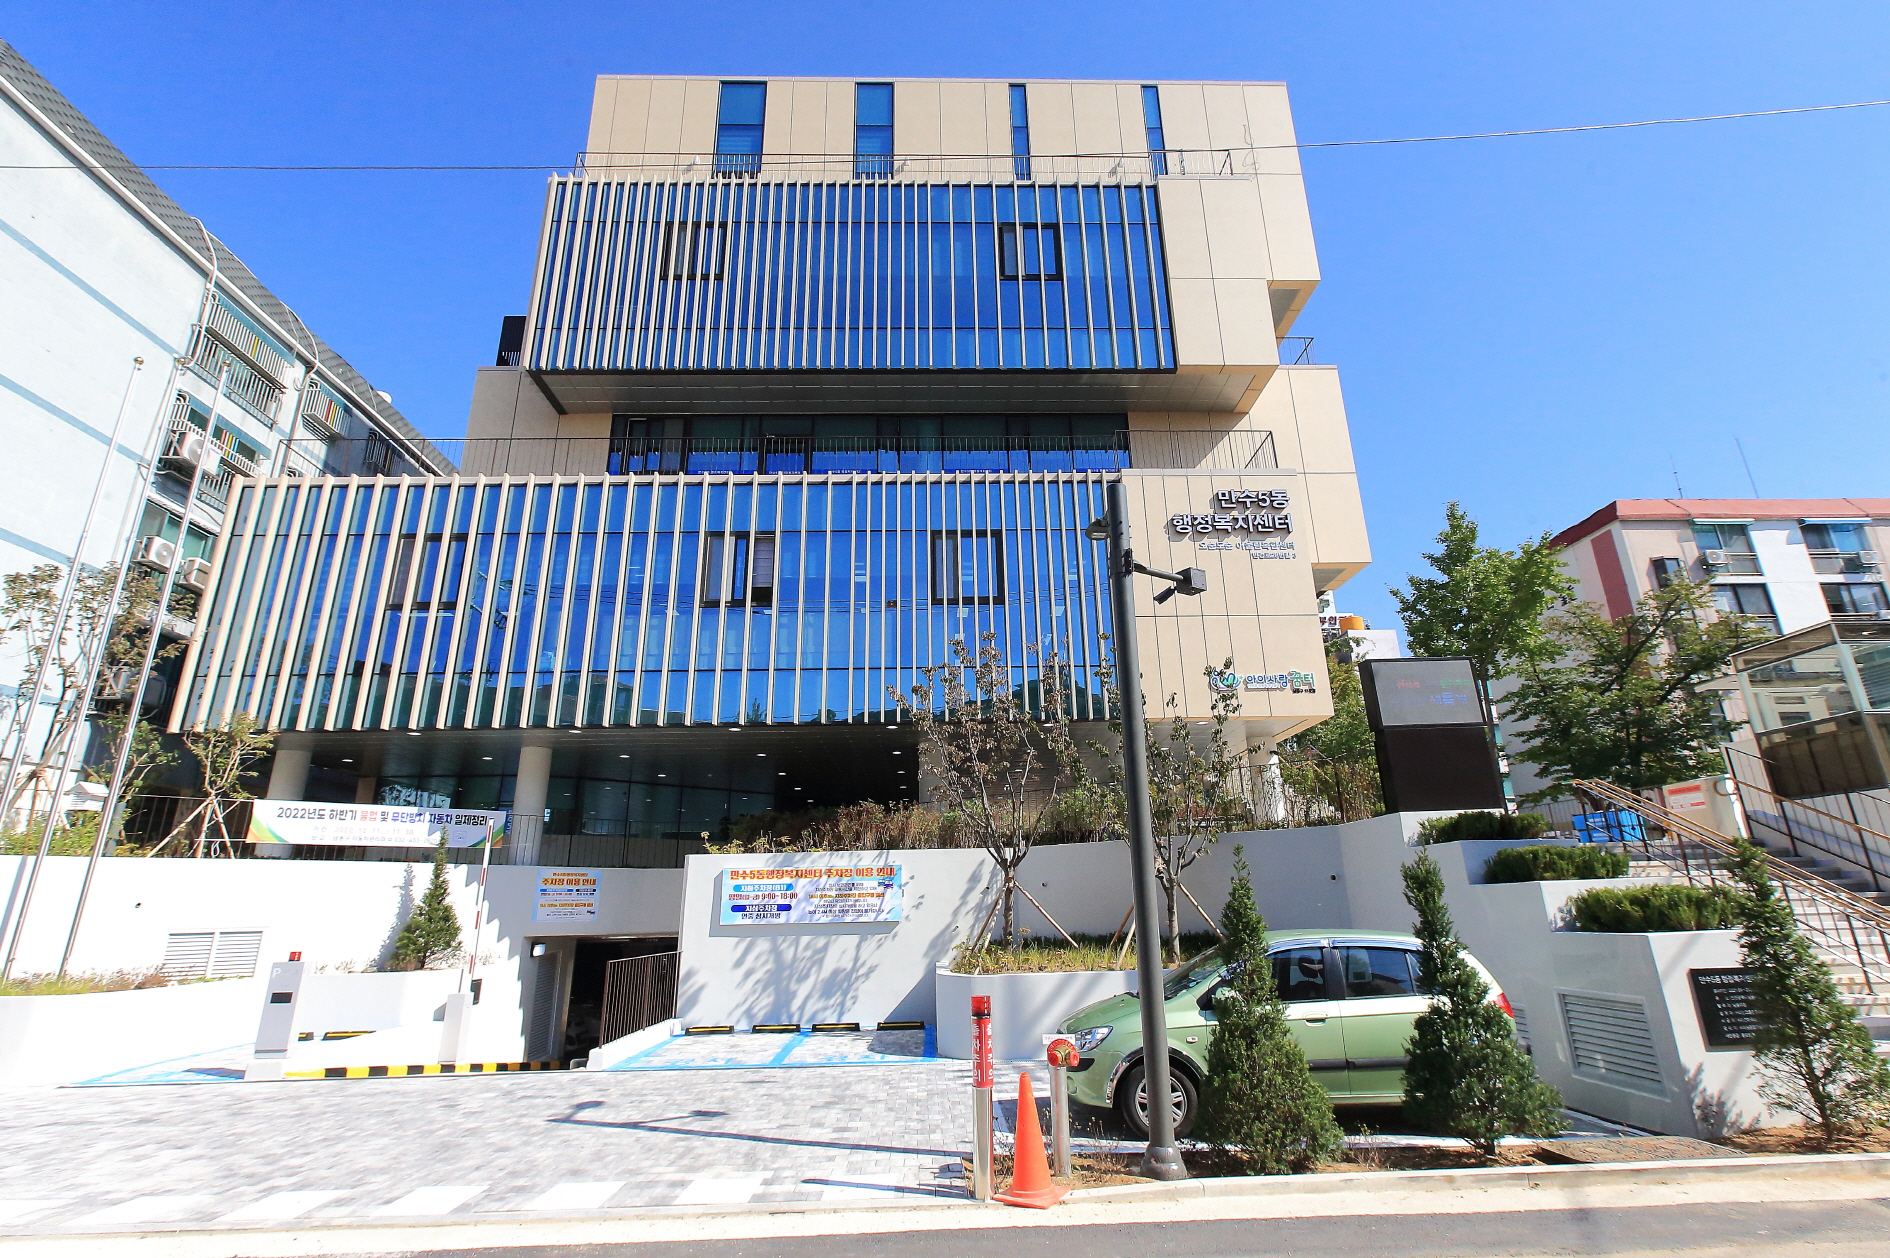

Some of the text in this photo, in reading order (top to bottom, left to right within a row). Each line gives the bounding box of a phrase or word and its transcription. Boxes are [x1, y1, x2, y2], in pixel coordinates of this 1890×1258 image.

[1217, 489, 1290, 508] 만수5동
[1172, 512, 1293, 533] 행정복지센터
[1247, 670, 1315, 688] 아이사랑꿈터
[277, 807, 488, 826] 2022년도 하반기 불법 및 무단방치 자동차 일제정리
[730, 867, 895, 880] 만수5동행정복지센터 주차장 이용 안내
